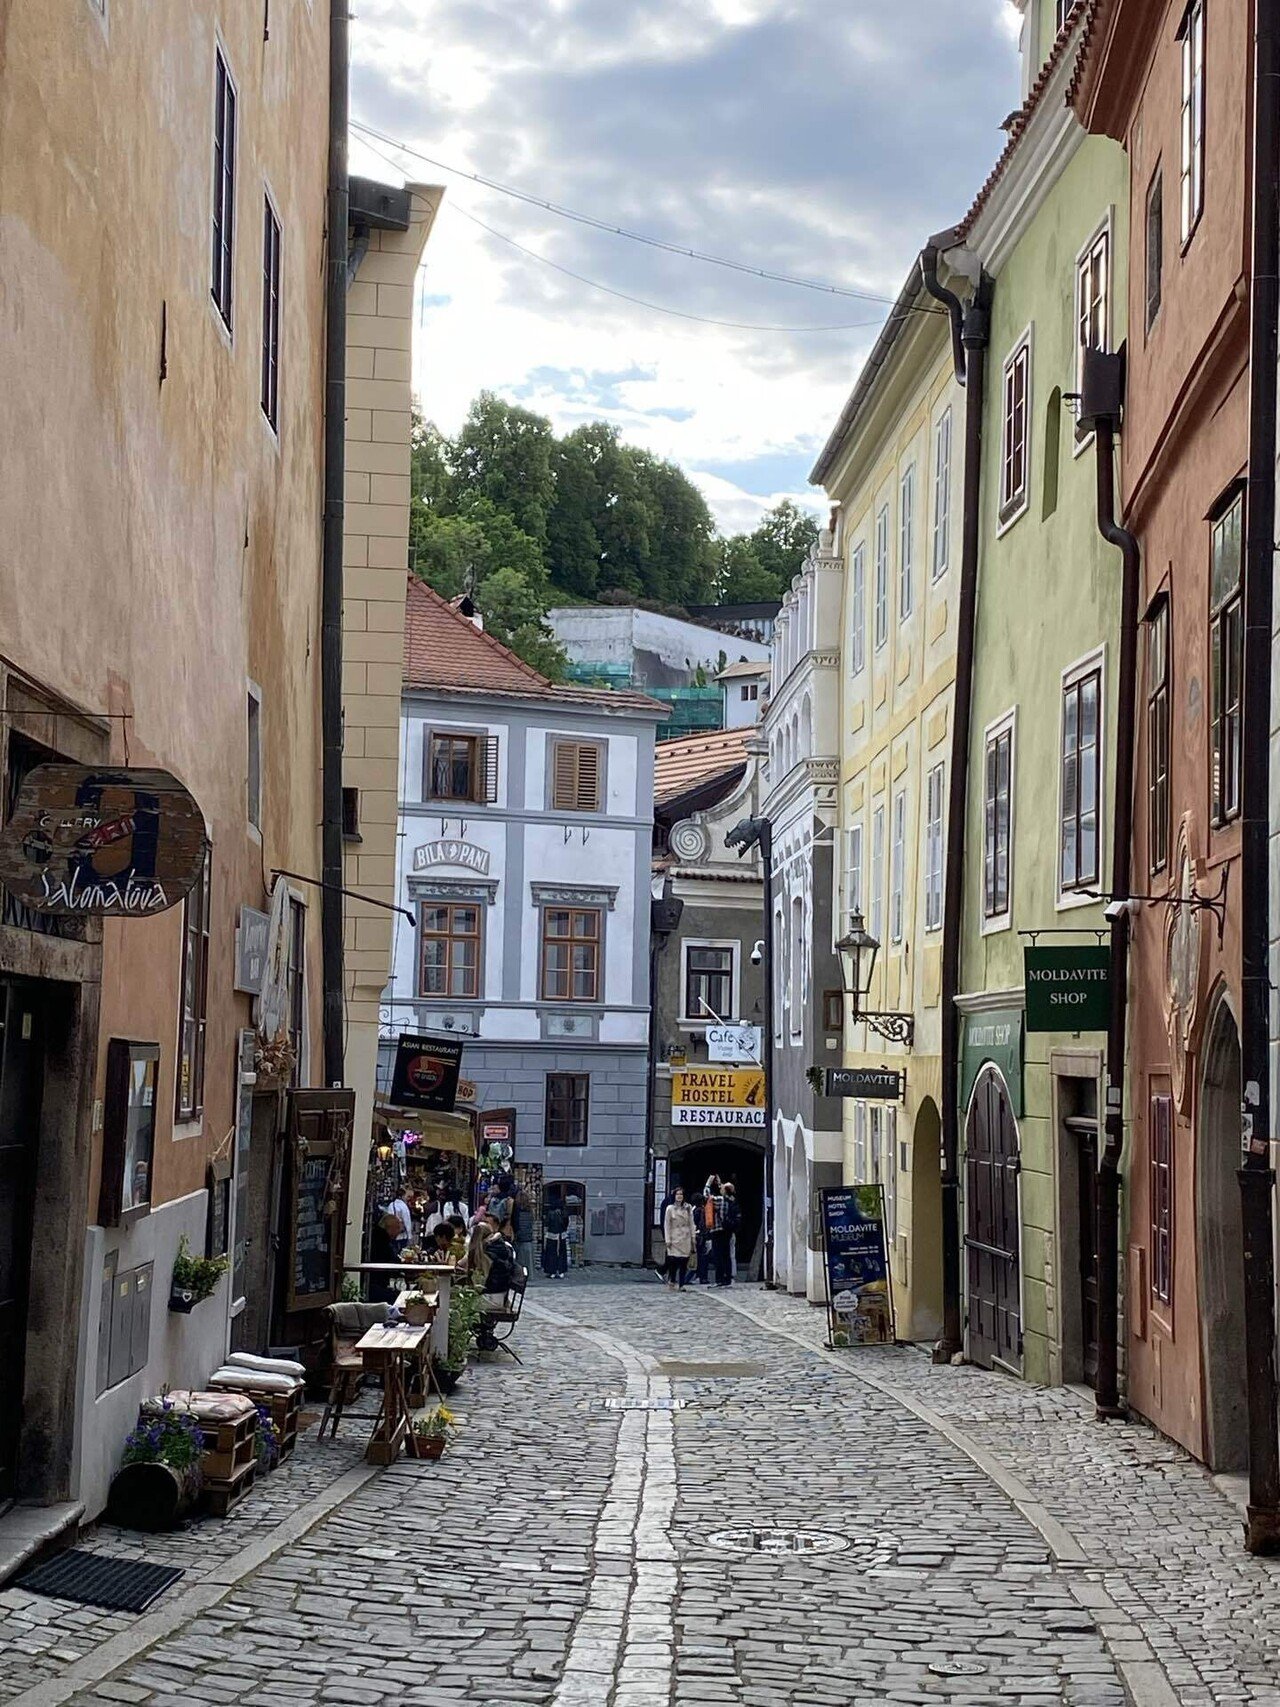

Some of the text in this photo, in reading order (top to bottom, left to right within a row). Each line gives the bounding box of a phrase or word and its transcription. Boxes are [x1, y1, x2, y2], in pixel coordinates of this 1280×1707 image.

[39, 815, 102, 829] GLLERY
[1029, 969, 1108, 981] MOLDAVITE
[1050, 992, 1088, 1004] SHOP
[401, 1040, 459, 1056] ASIAN RESTAURANT
[681, 1073, 736, 1088] TRAVEL
[833, 1072, 896, 1085] MOLDAVITE
[681, 1089, 735, 1103] HOSTEL
[679, 1109, 766, 1124] RESTAURAC
[830, 1223, 878, 1235] MOLDAVITE
